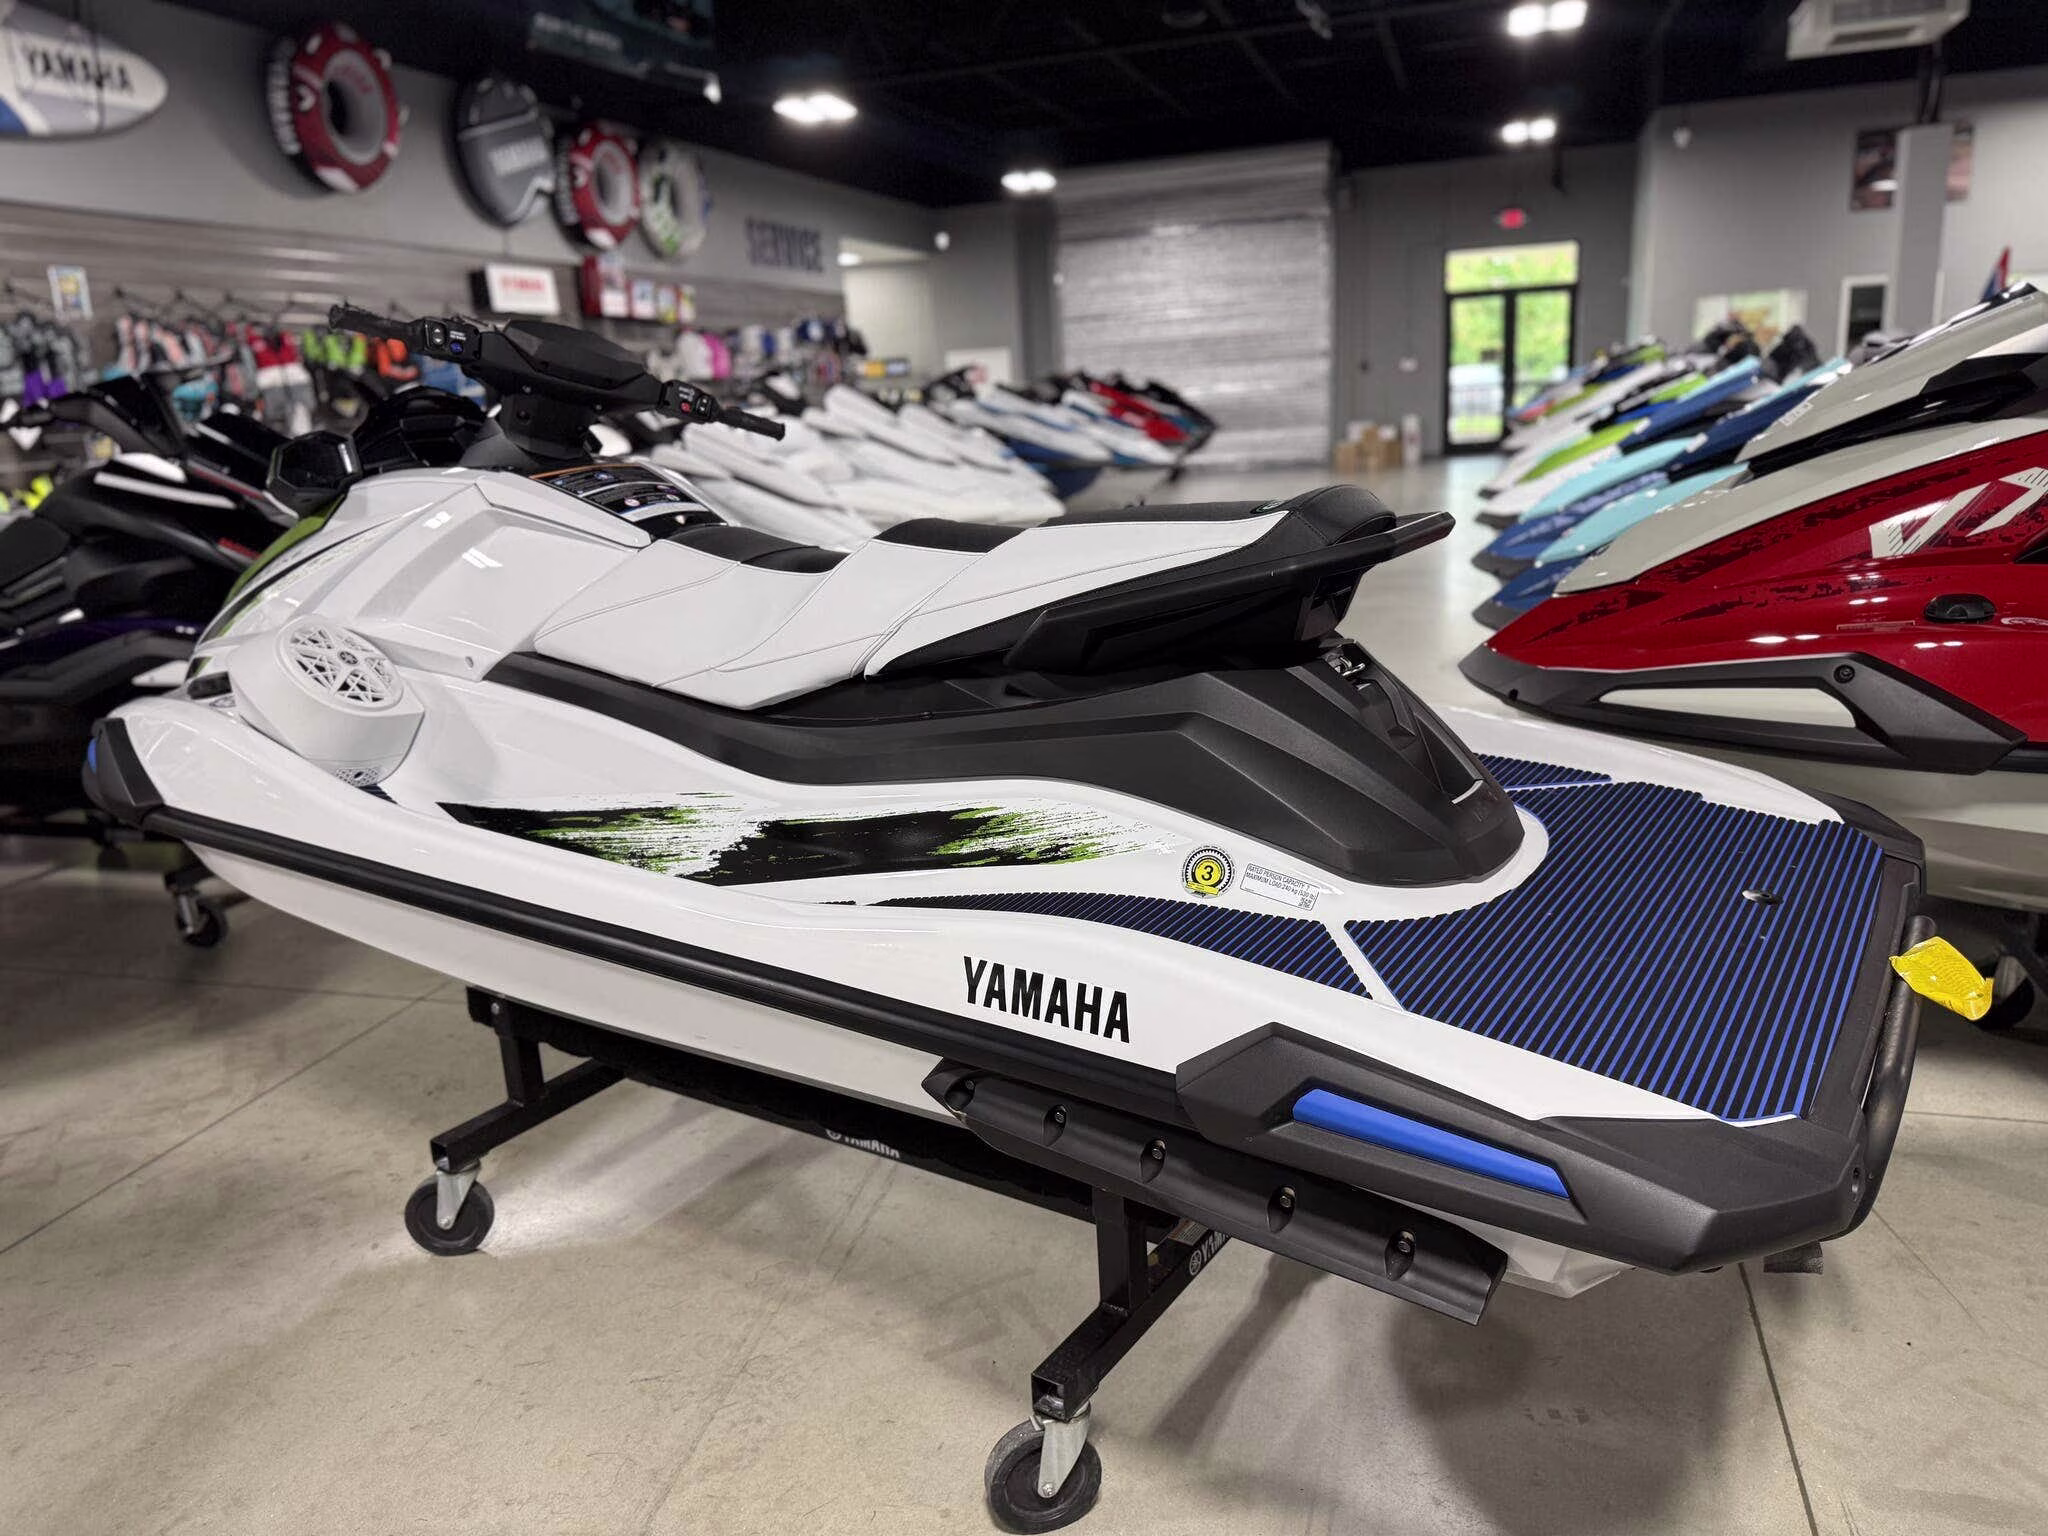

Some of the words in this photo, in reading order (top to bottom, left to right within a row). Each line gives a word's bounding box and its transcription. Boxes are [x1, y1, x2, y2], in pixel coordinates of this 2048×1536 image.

[1201, 865, 1214, 881] 3
[1246, 872, 1269, 884] MAXIMUM
[1247, 865, 1263, 875] RATED
[1263, 869, 1282, 881] PERSON
[963, 956, 1131, 1043] YAMAHA
